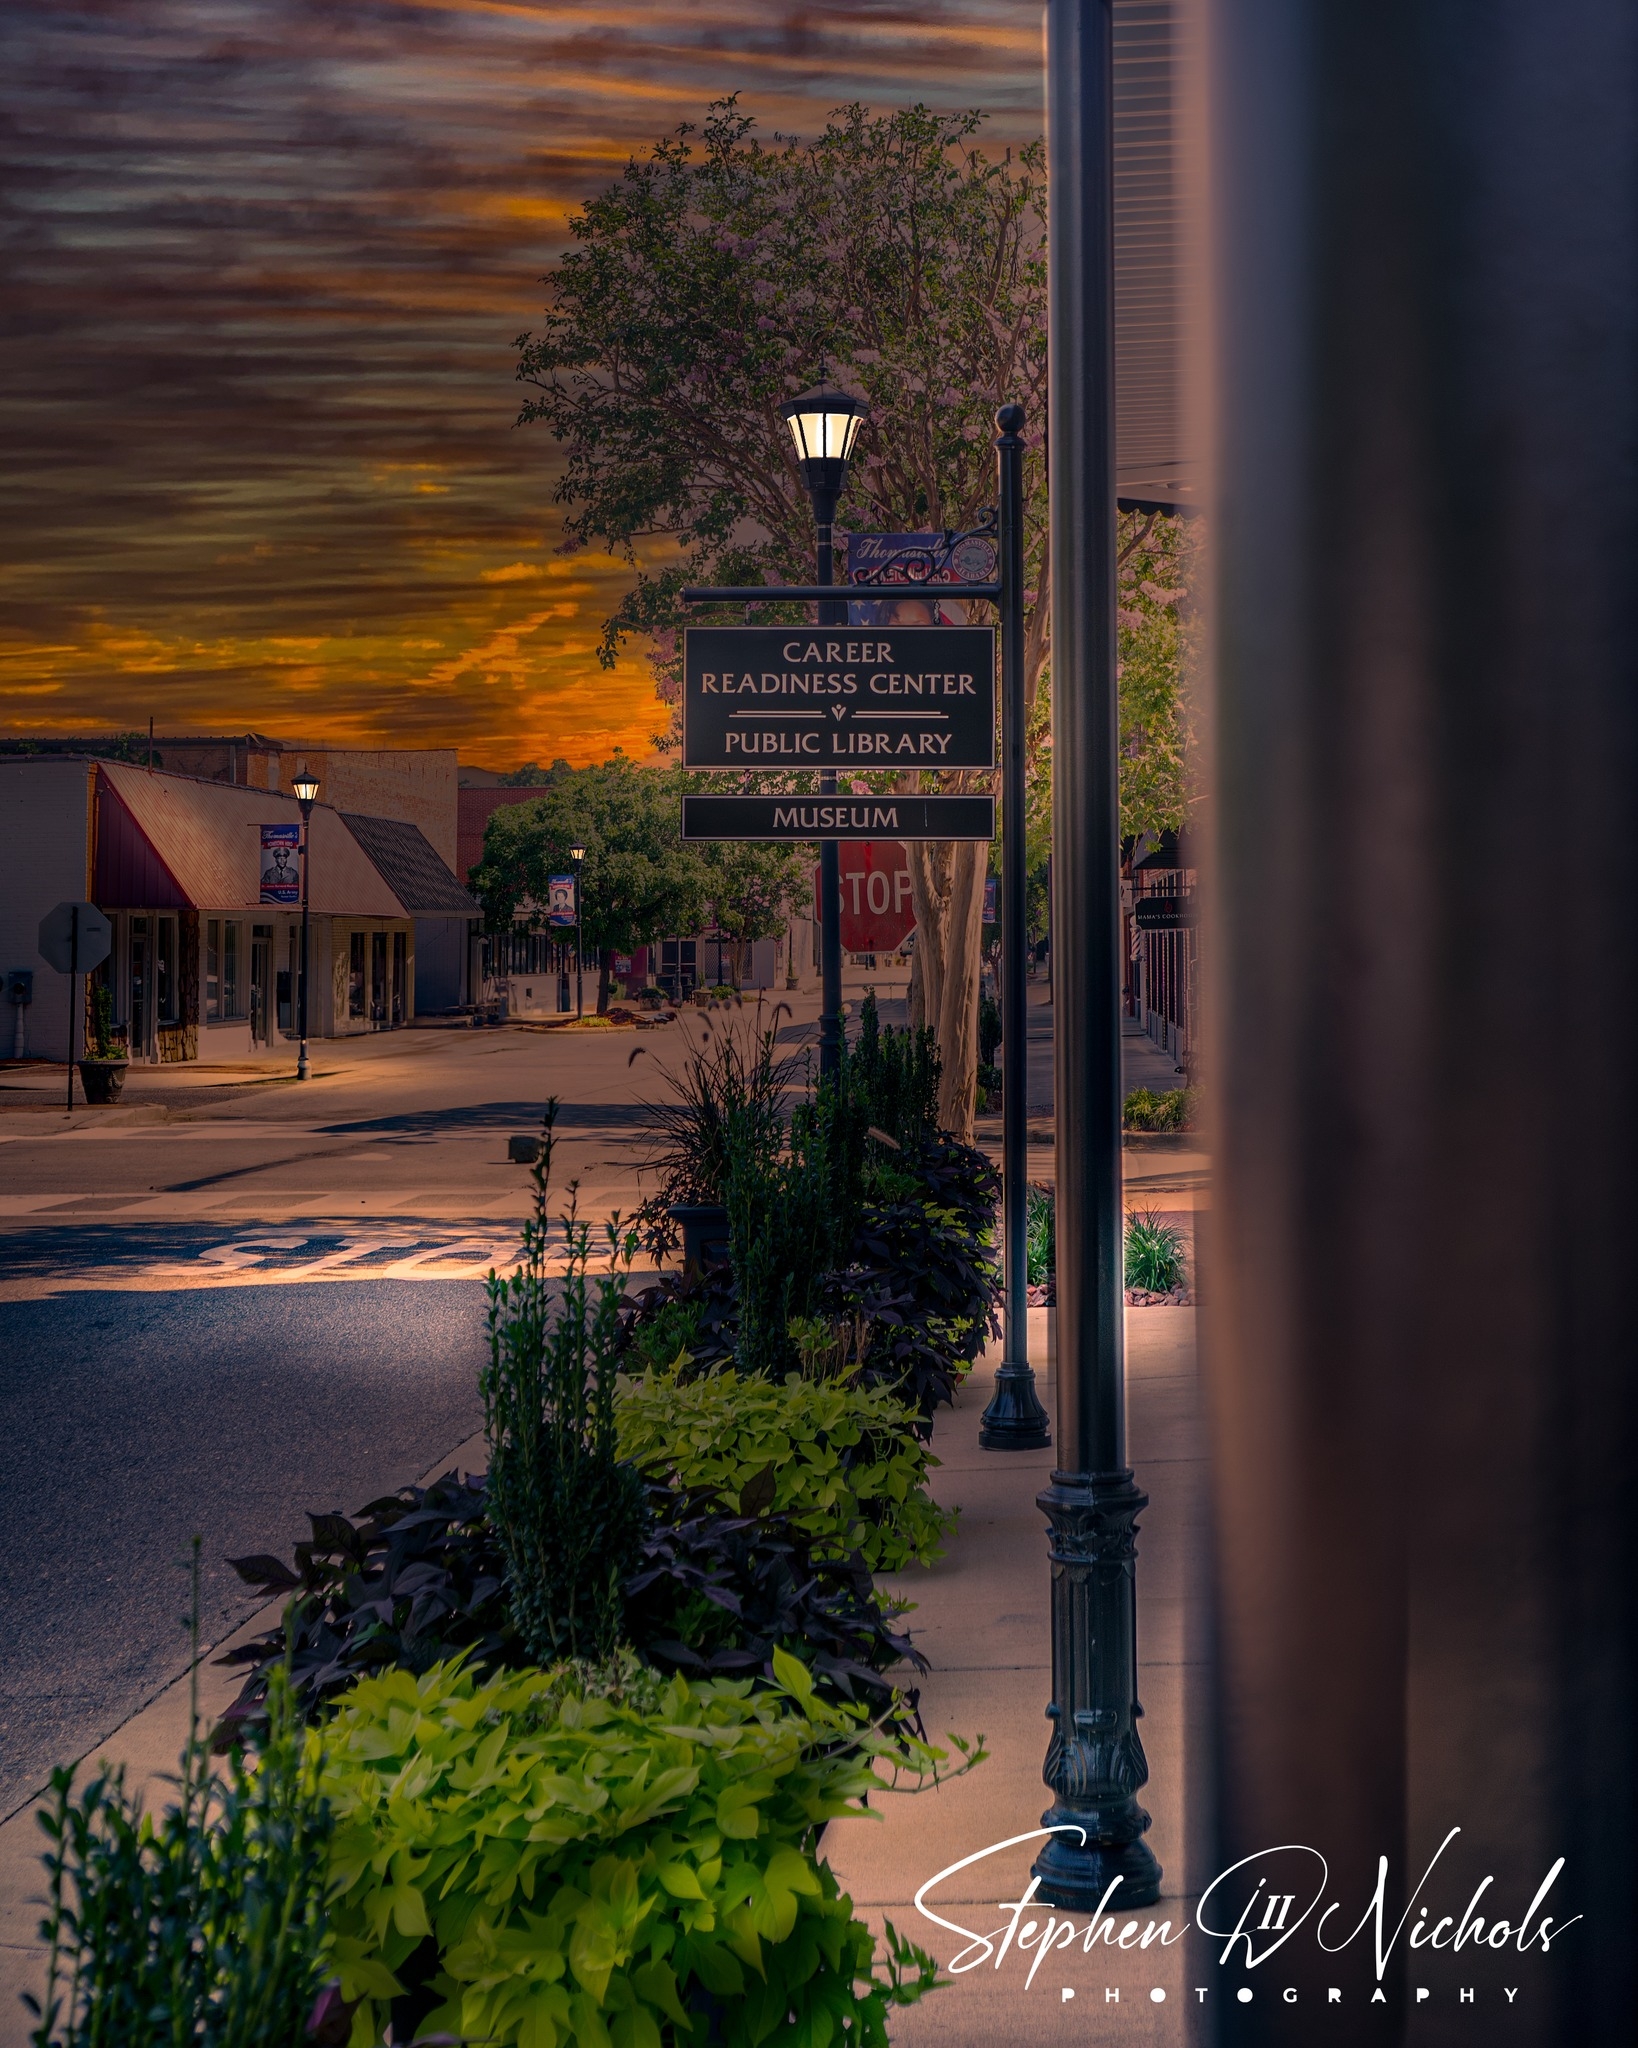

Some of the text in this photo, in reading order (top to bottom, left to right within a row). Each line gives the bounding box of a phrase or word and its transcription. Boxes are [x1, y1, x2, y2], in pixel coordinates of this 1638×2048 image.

[782, 641, 895, 664] CAREER
[701, 673, 977, 696] READINESS CENTER
[725, 732, 953, 755] PUBLIC LIBRARY
[772, 807, 900, 829] MUSEUM
[839, 870, 913, 916] TOP
